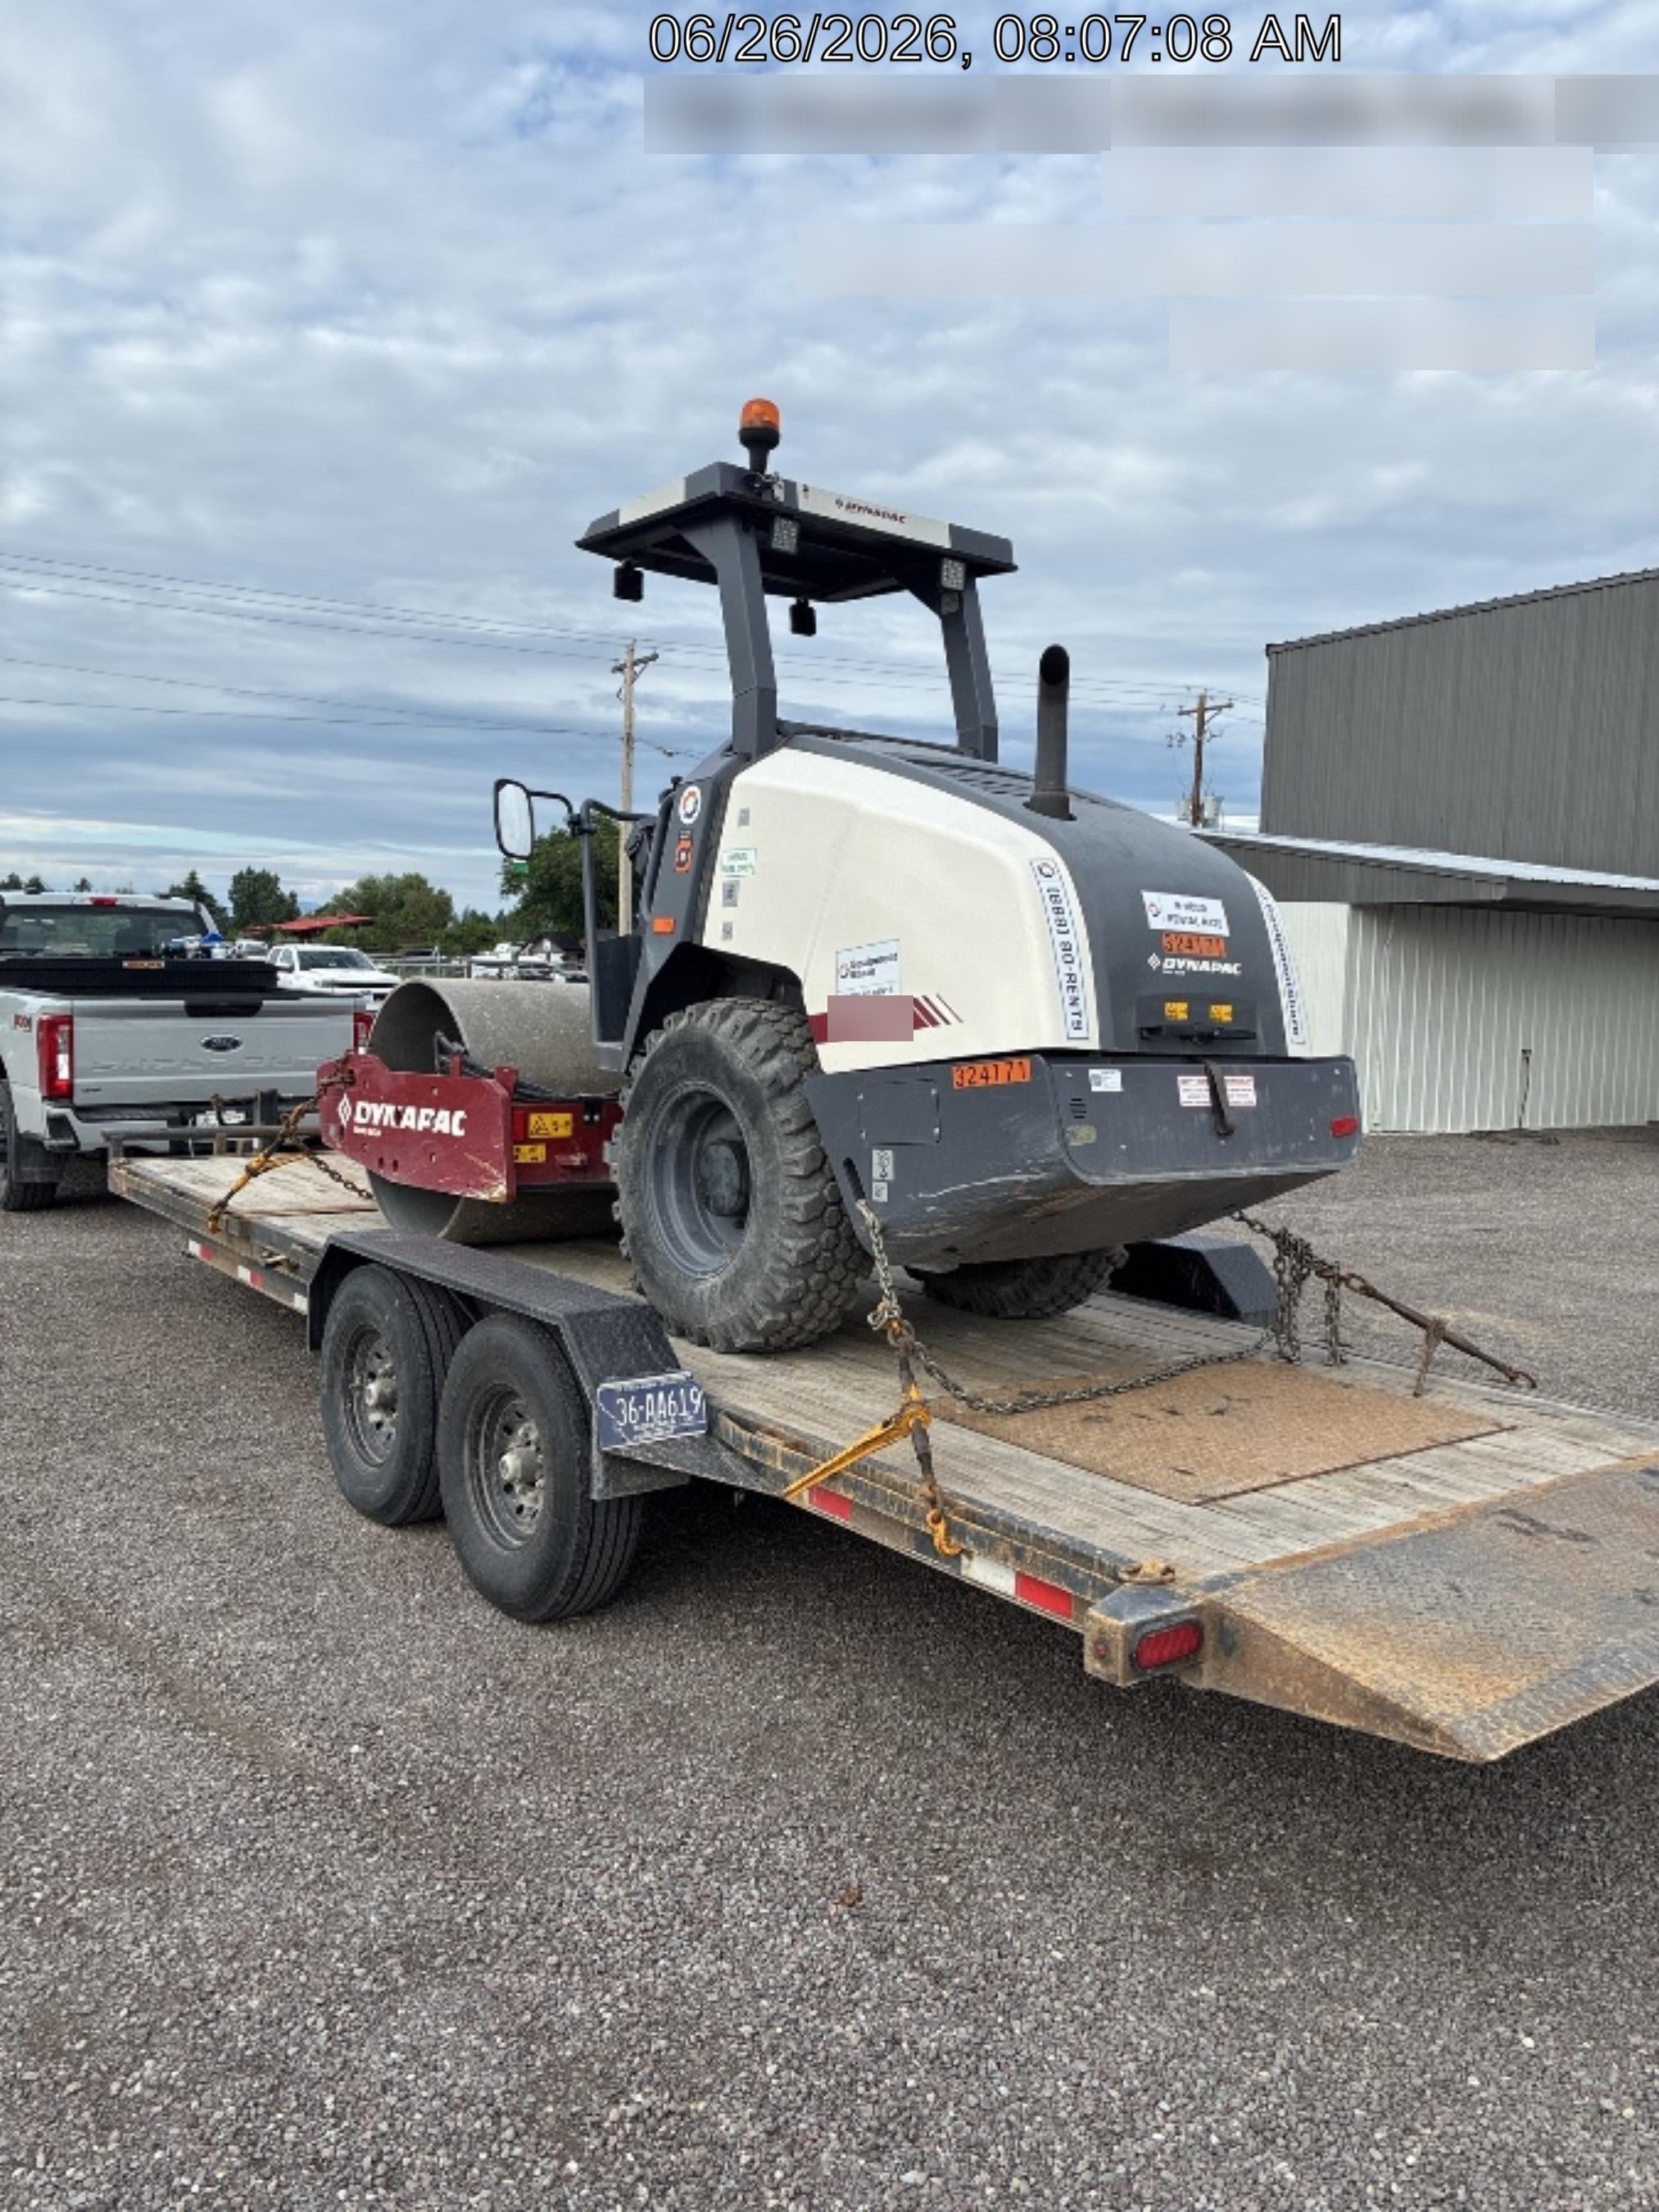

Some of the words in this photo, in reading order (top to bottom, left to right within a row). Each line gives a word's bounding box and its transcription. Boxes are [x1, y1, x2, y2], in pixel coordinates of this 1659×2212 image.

[1163, 958, 1242, 976] DYNAPAC
[955, 1061, 1027, 1087] 324171
[354, 1100, 468, 1137] DYNAPAC
